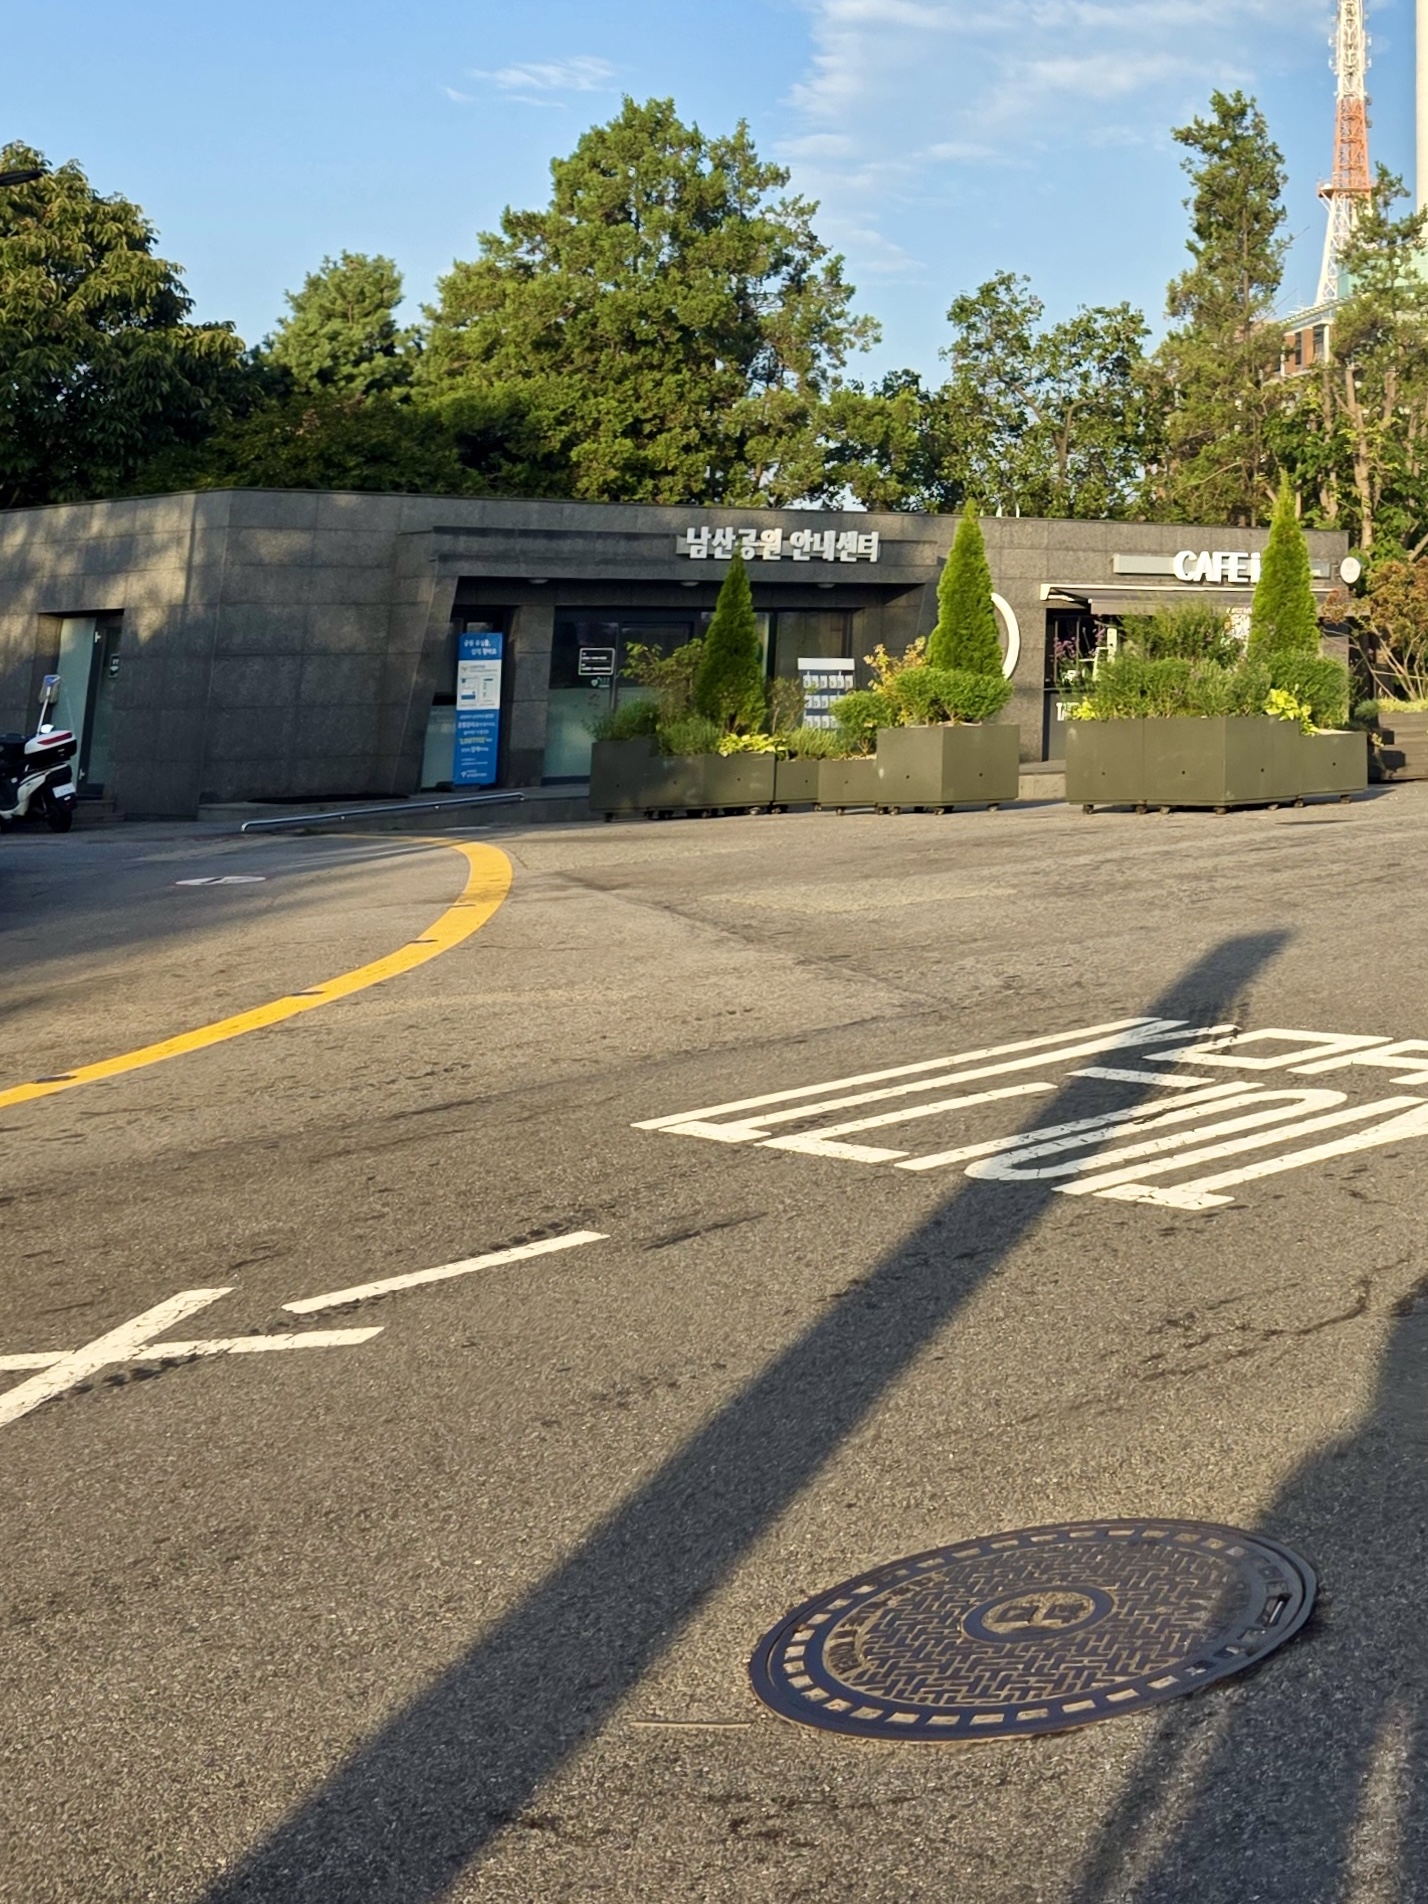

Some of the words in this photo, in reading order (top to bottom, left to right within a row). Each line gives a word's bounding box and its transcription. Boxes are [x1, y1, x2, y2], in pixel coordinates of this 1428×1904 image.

[686, 526, 783, 561] 남산공원
[790, 529, 880, 563] 안내센터
[1173, 550, 1249, 583] CAFE
